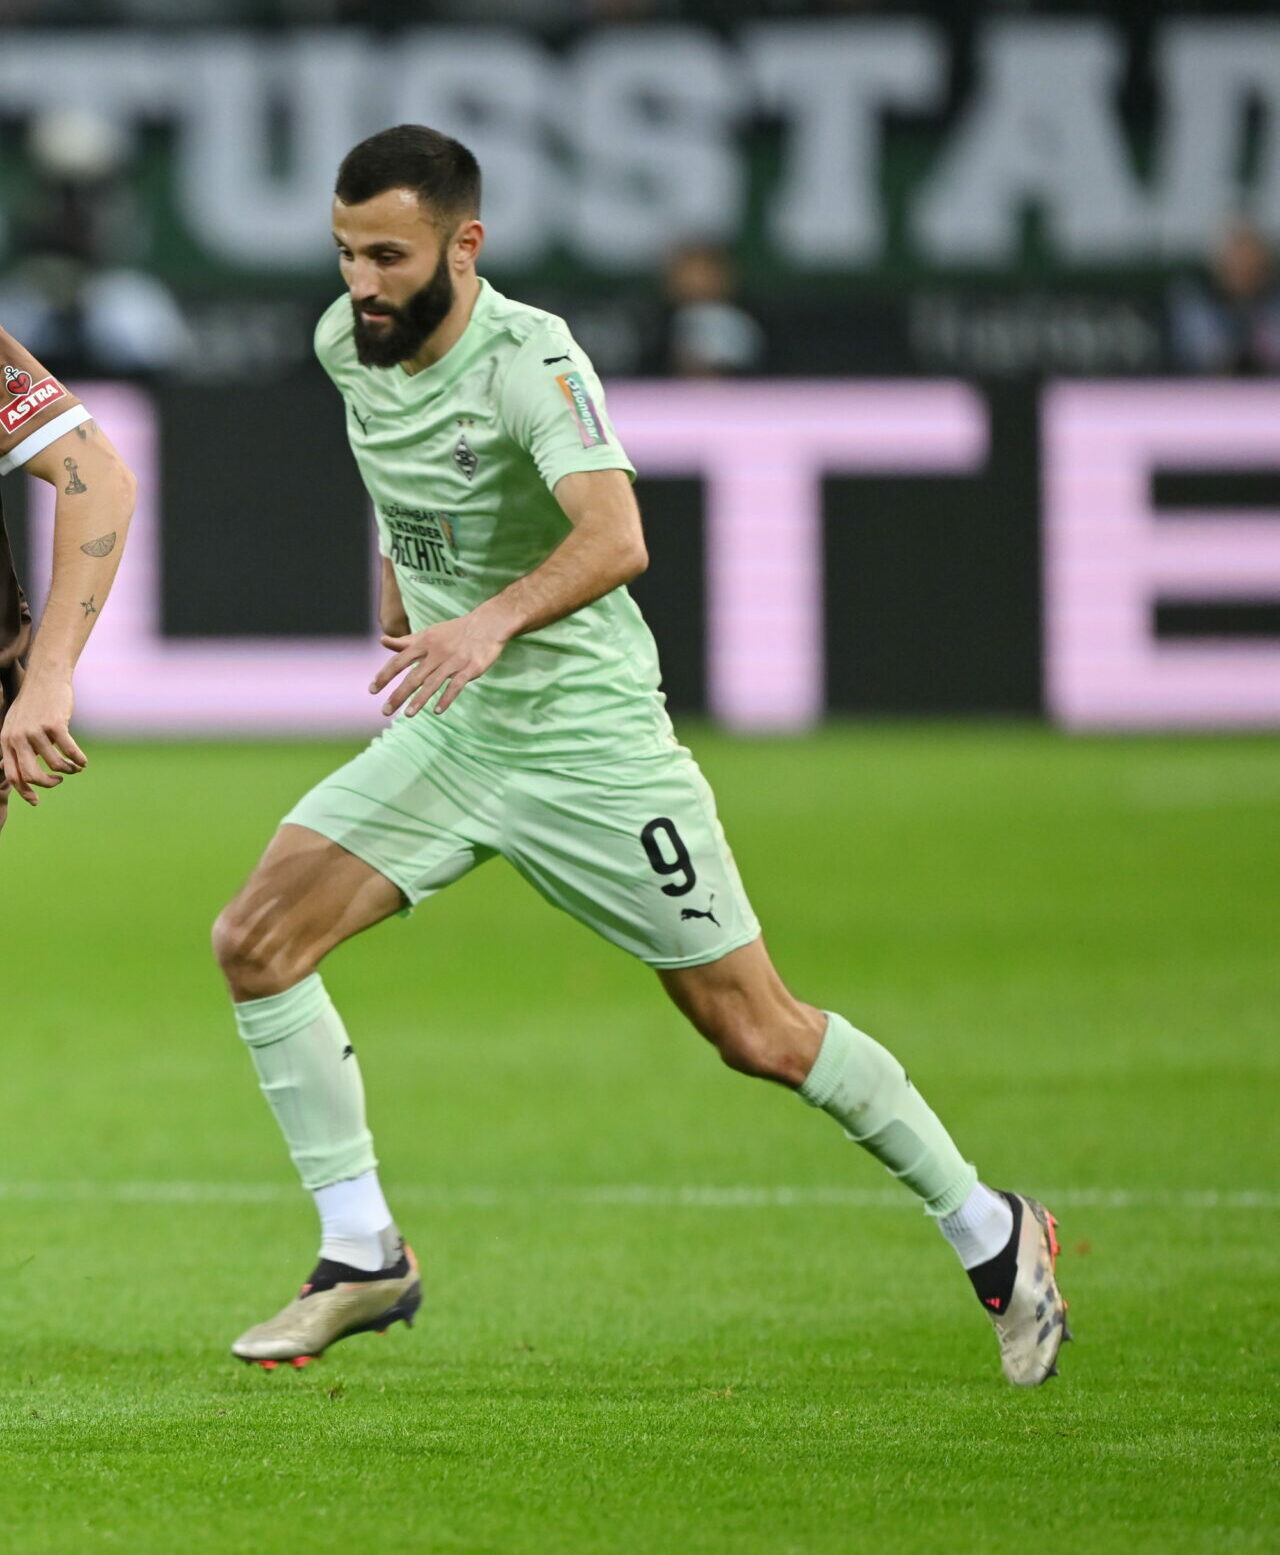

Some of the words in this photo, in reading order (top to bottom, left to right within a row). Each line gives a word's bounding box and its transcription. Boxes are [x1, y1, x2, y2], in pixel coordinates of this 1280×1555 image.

[7, 384, 59, 425] ASTRA
[397, 519, 443, 541] KINDER
[640, 817, 697, 897] 9
